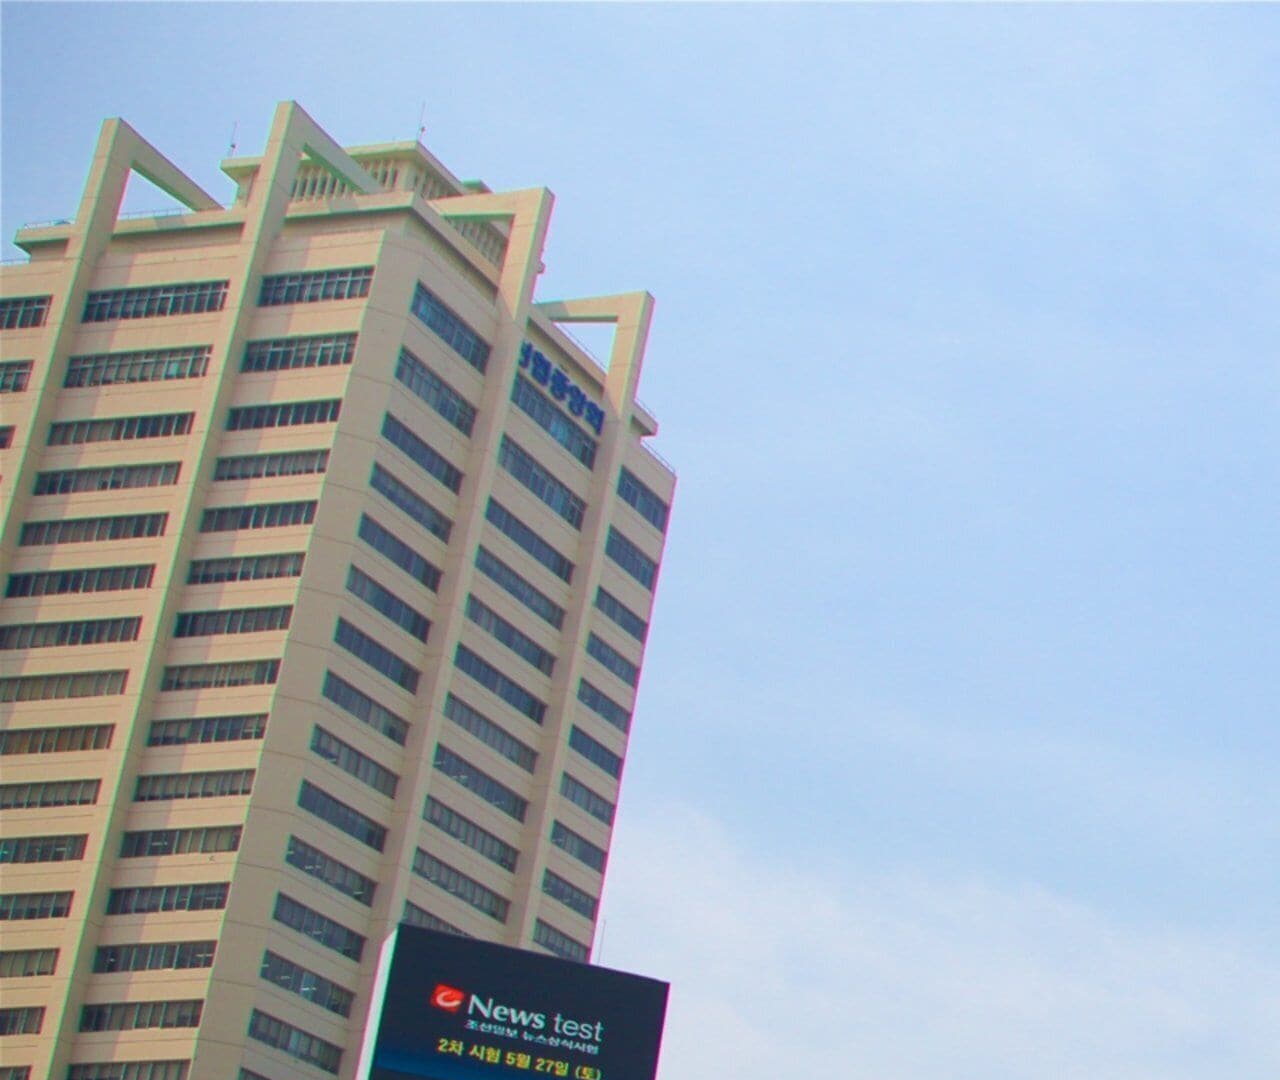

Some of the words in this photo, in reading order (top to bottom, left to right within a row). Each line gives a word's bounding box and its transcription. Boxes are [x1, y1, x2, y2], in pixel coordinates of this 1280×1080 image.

[468, 994, 546, 1030] News
[554, 1012, 604, 1043] test
[437, 1037, 464, 1057] 2차
[469, 1044, 501, 1065] 시험
[505, 1052, 532, 1070] 5월
[535, 1057, 570, 1078] 27일
